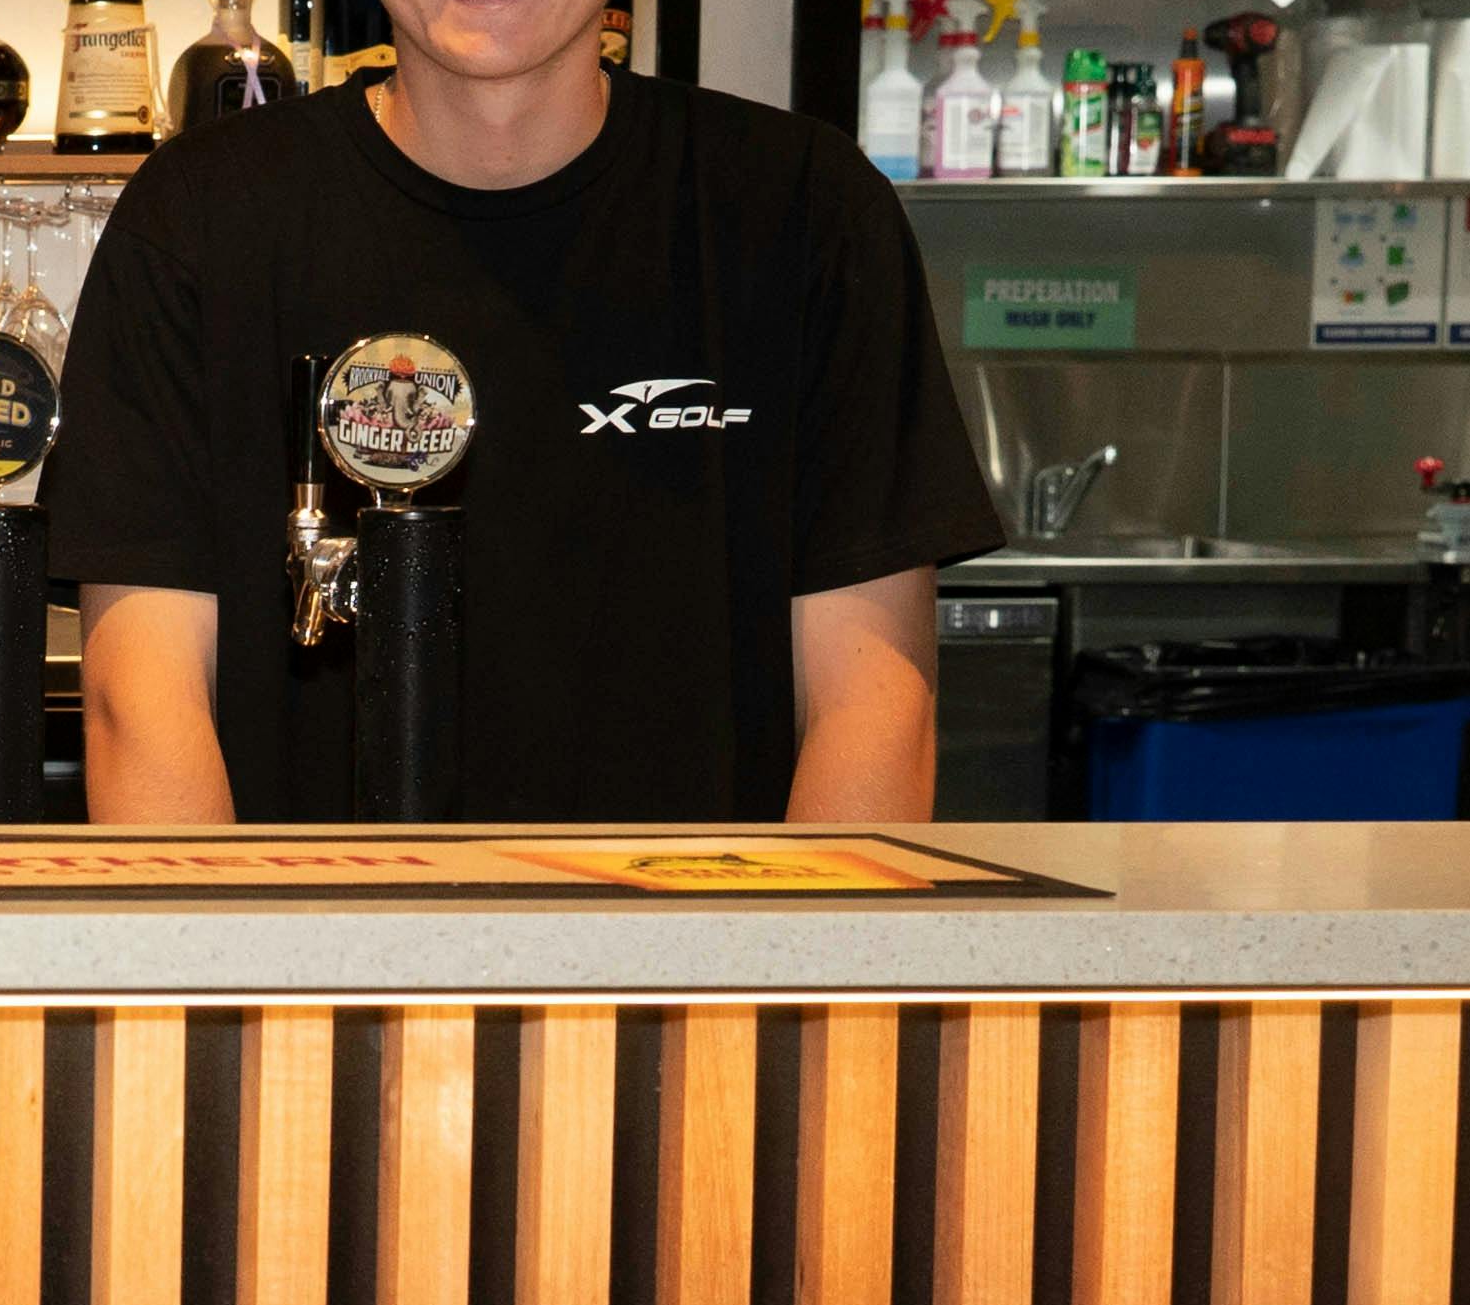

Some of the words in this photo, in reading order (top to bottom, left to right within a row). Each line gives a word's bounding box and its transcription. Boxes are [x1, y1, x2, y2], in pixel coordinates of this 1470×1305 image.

[414, 371, 456, 401] UNION
[578, 403, 637, 434] X
[648, 406, 753, 430] GOLF
[339, 417, 404, 453] GINGER
